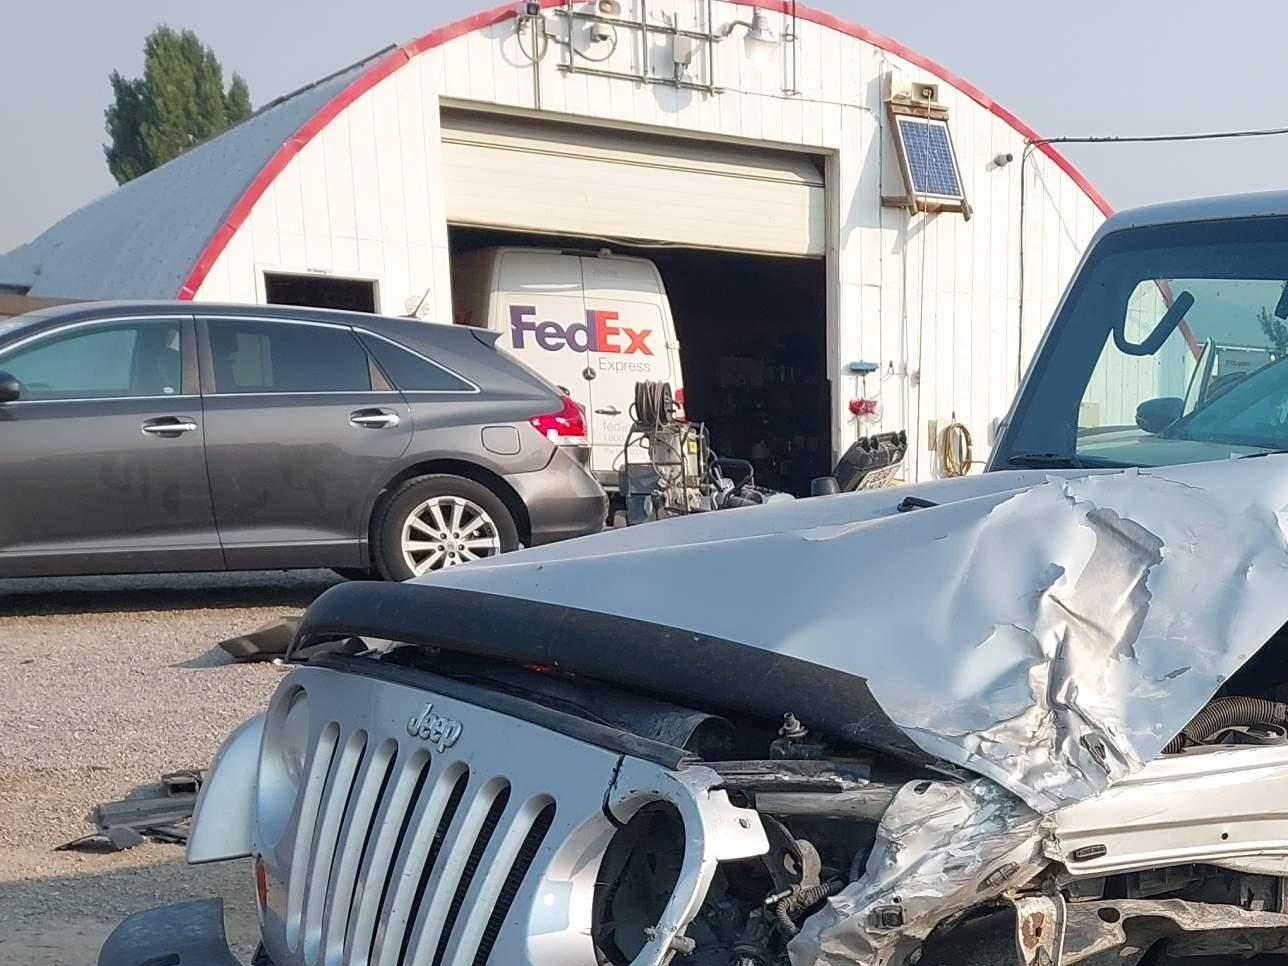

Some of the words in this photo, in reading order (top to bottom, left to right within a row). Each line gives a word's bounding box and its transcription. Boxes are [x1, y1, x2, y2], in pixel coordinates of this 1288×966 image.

[509, 304, 655, 356] FedEx
[598, 357, 651, 373] Express
[407, 702, 463, 753] Jeep
